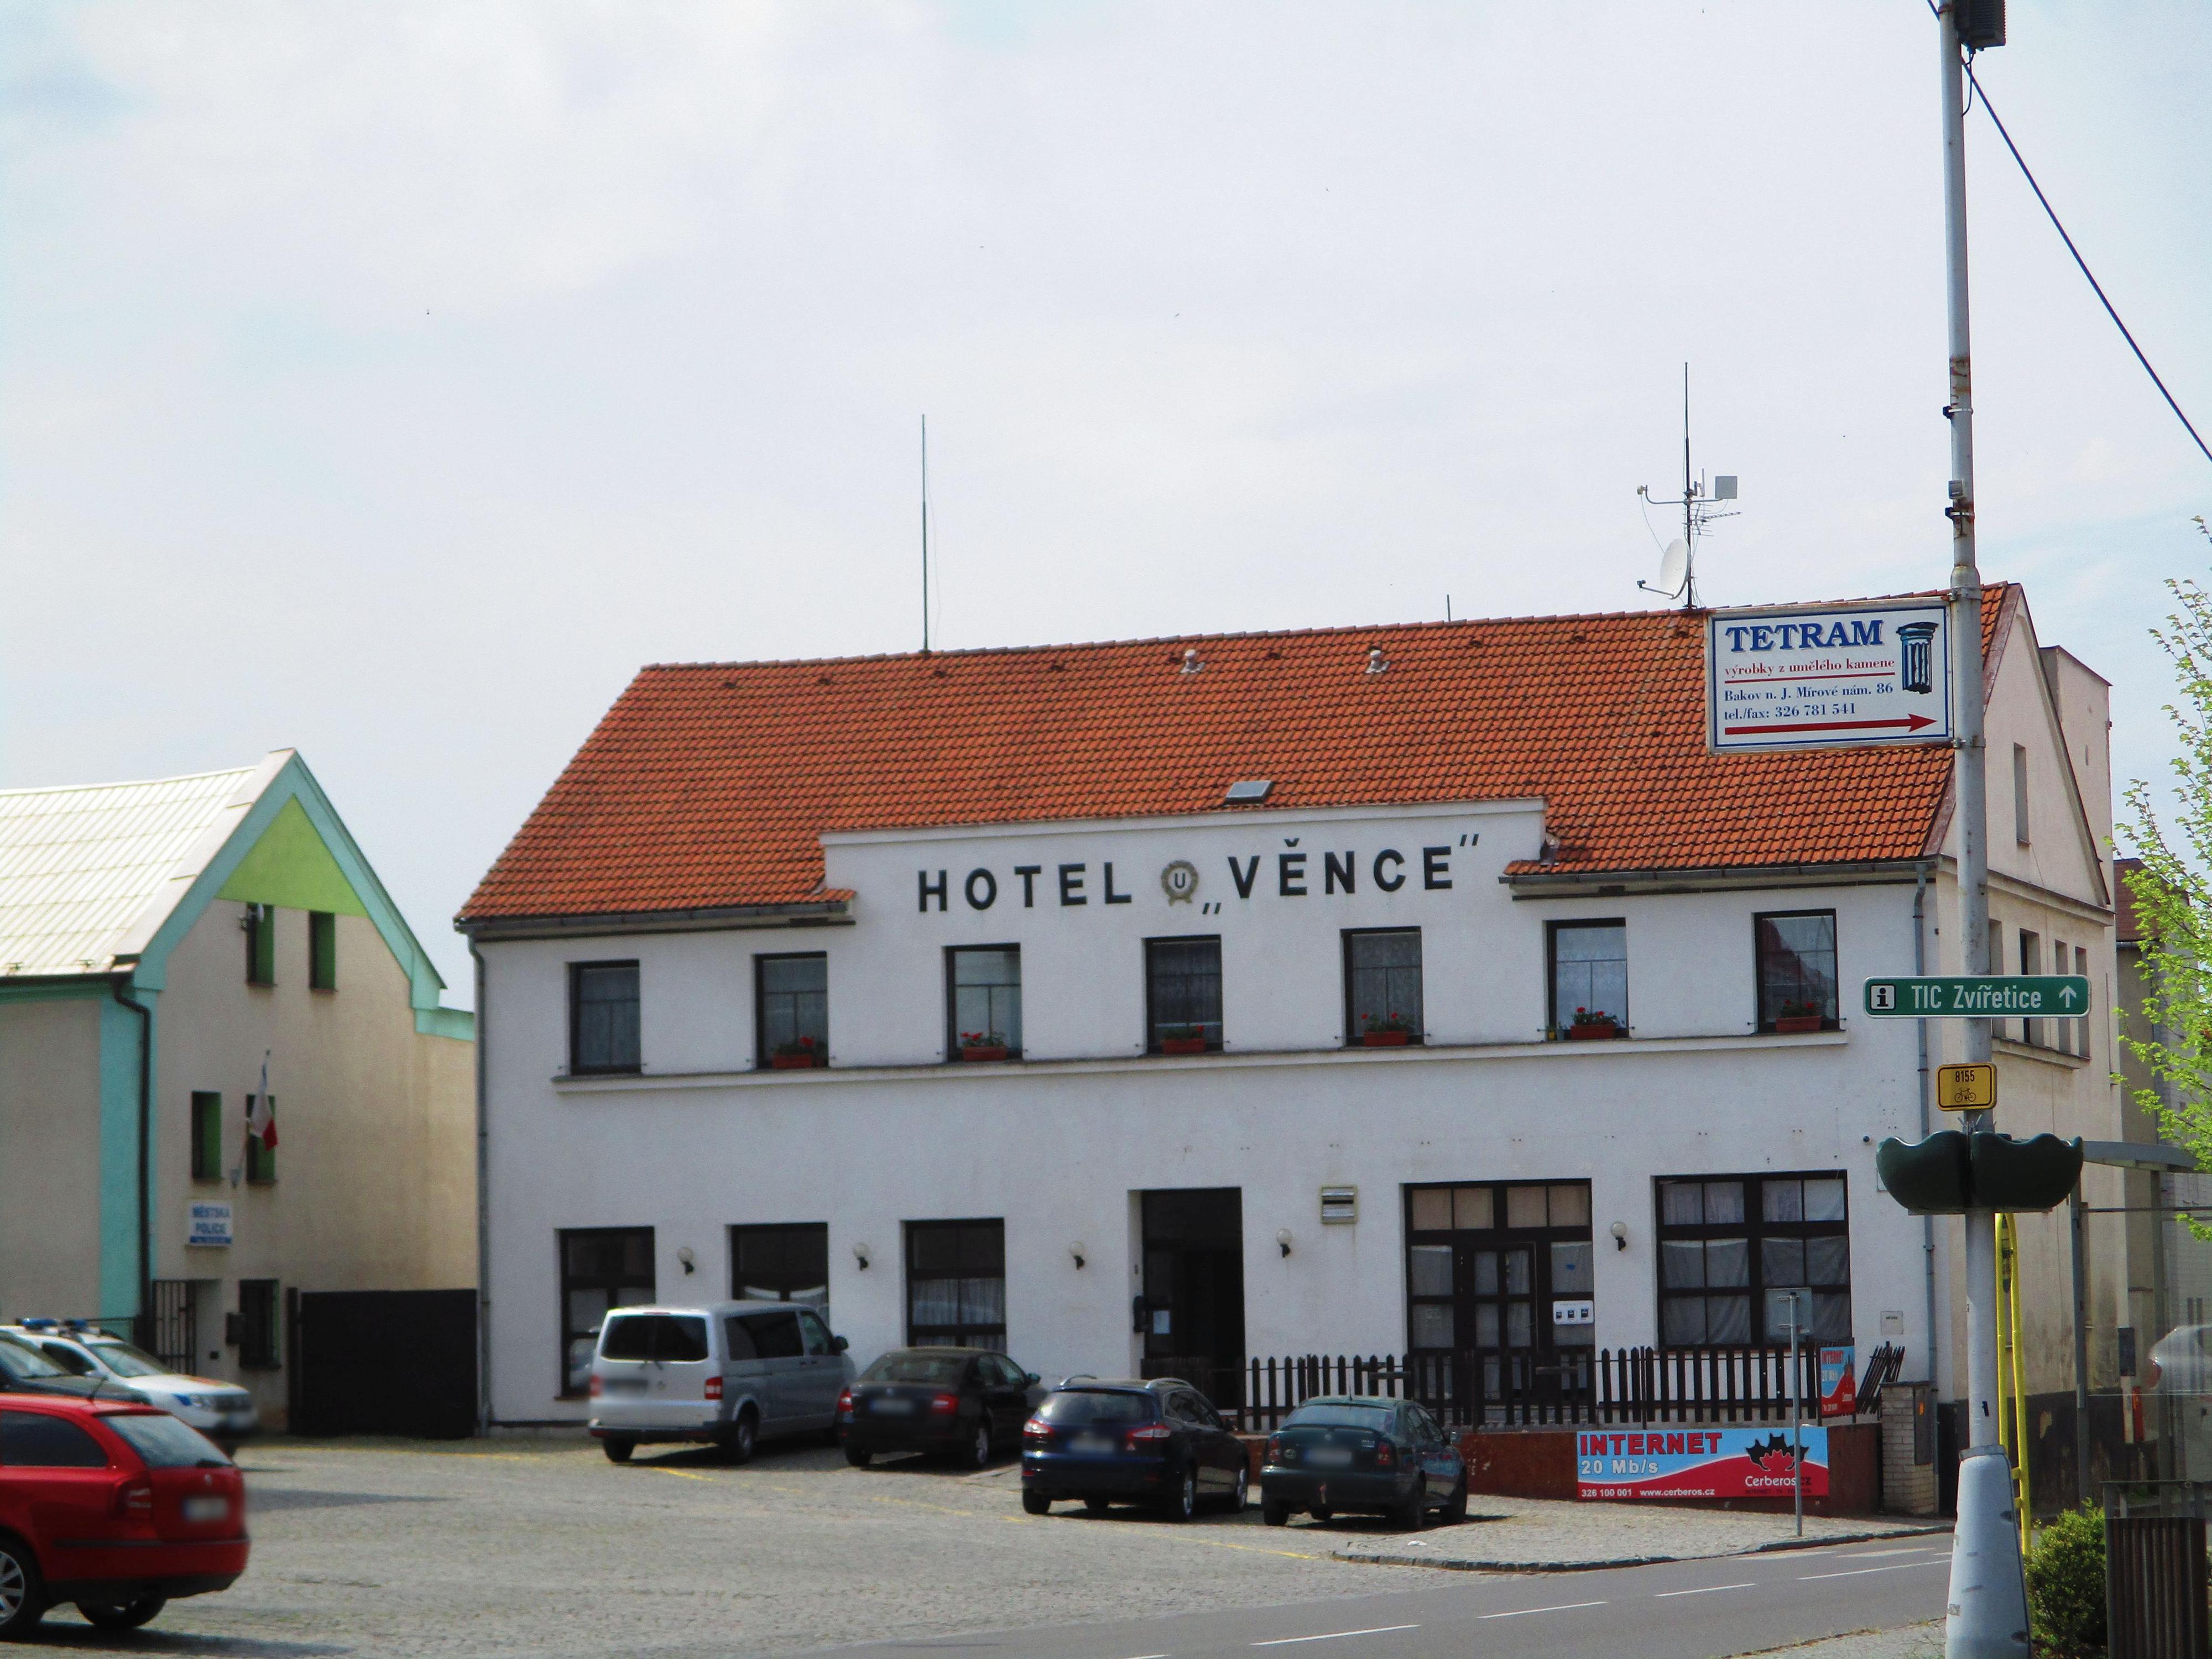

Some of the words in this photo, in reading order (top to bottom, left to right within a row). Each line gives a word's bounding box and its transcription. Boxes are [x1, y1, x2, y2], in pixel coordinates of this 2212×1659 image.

[1725, 620, 1884, 652] TETRAM
[1725, 662, 1773, 678] výrobky
[1790, 659, 1841, 672] umělého
[1846, 658, 1895, 669] kamene
[1724, 690, 1761, 701] Bakov
[1781, 687, 1791, 700] J.
[1796, 685, 1838, 698] Mírové
[1843, 685, 1871, 696] nám.
[1876, 682, 1893, 694] 86
[1724, 708, 1770, 720] tel./fax:
[1775, 706, 1799, 718] 326
[1804, 704, 1827, 716] 781
[1832, 703, 1855, 715] 541
[918, 862, 1132, 912] HOTEL
[1911, 985, 1942, 1009] TIC
[1953, 985, 2042, 1009] Zvířetice
[1955, 1070, 1975, 1082] 8155
[1580, 1432, 1722, 1455] INTERNET
[1582, 1459, 1603, 1475] 20
[1612, 1458, 1658, 1474] Mb/s
[1582, 1489, 1597, 1497] 326
[1617, 1488, 1632, 1496] 001
[1640, 1488, 1715, 1496] www.cerberos.cz
